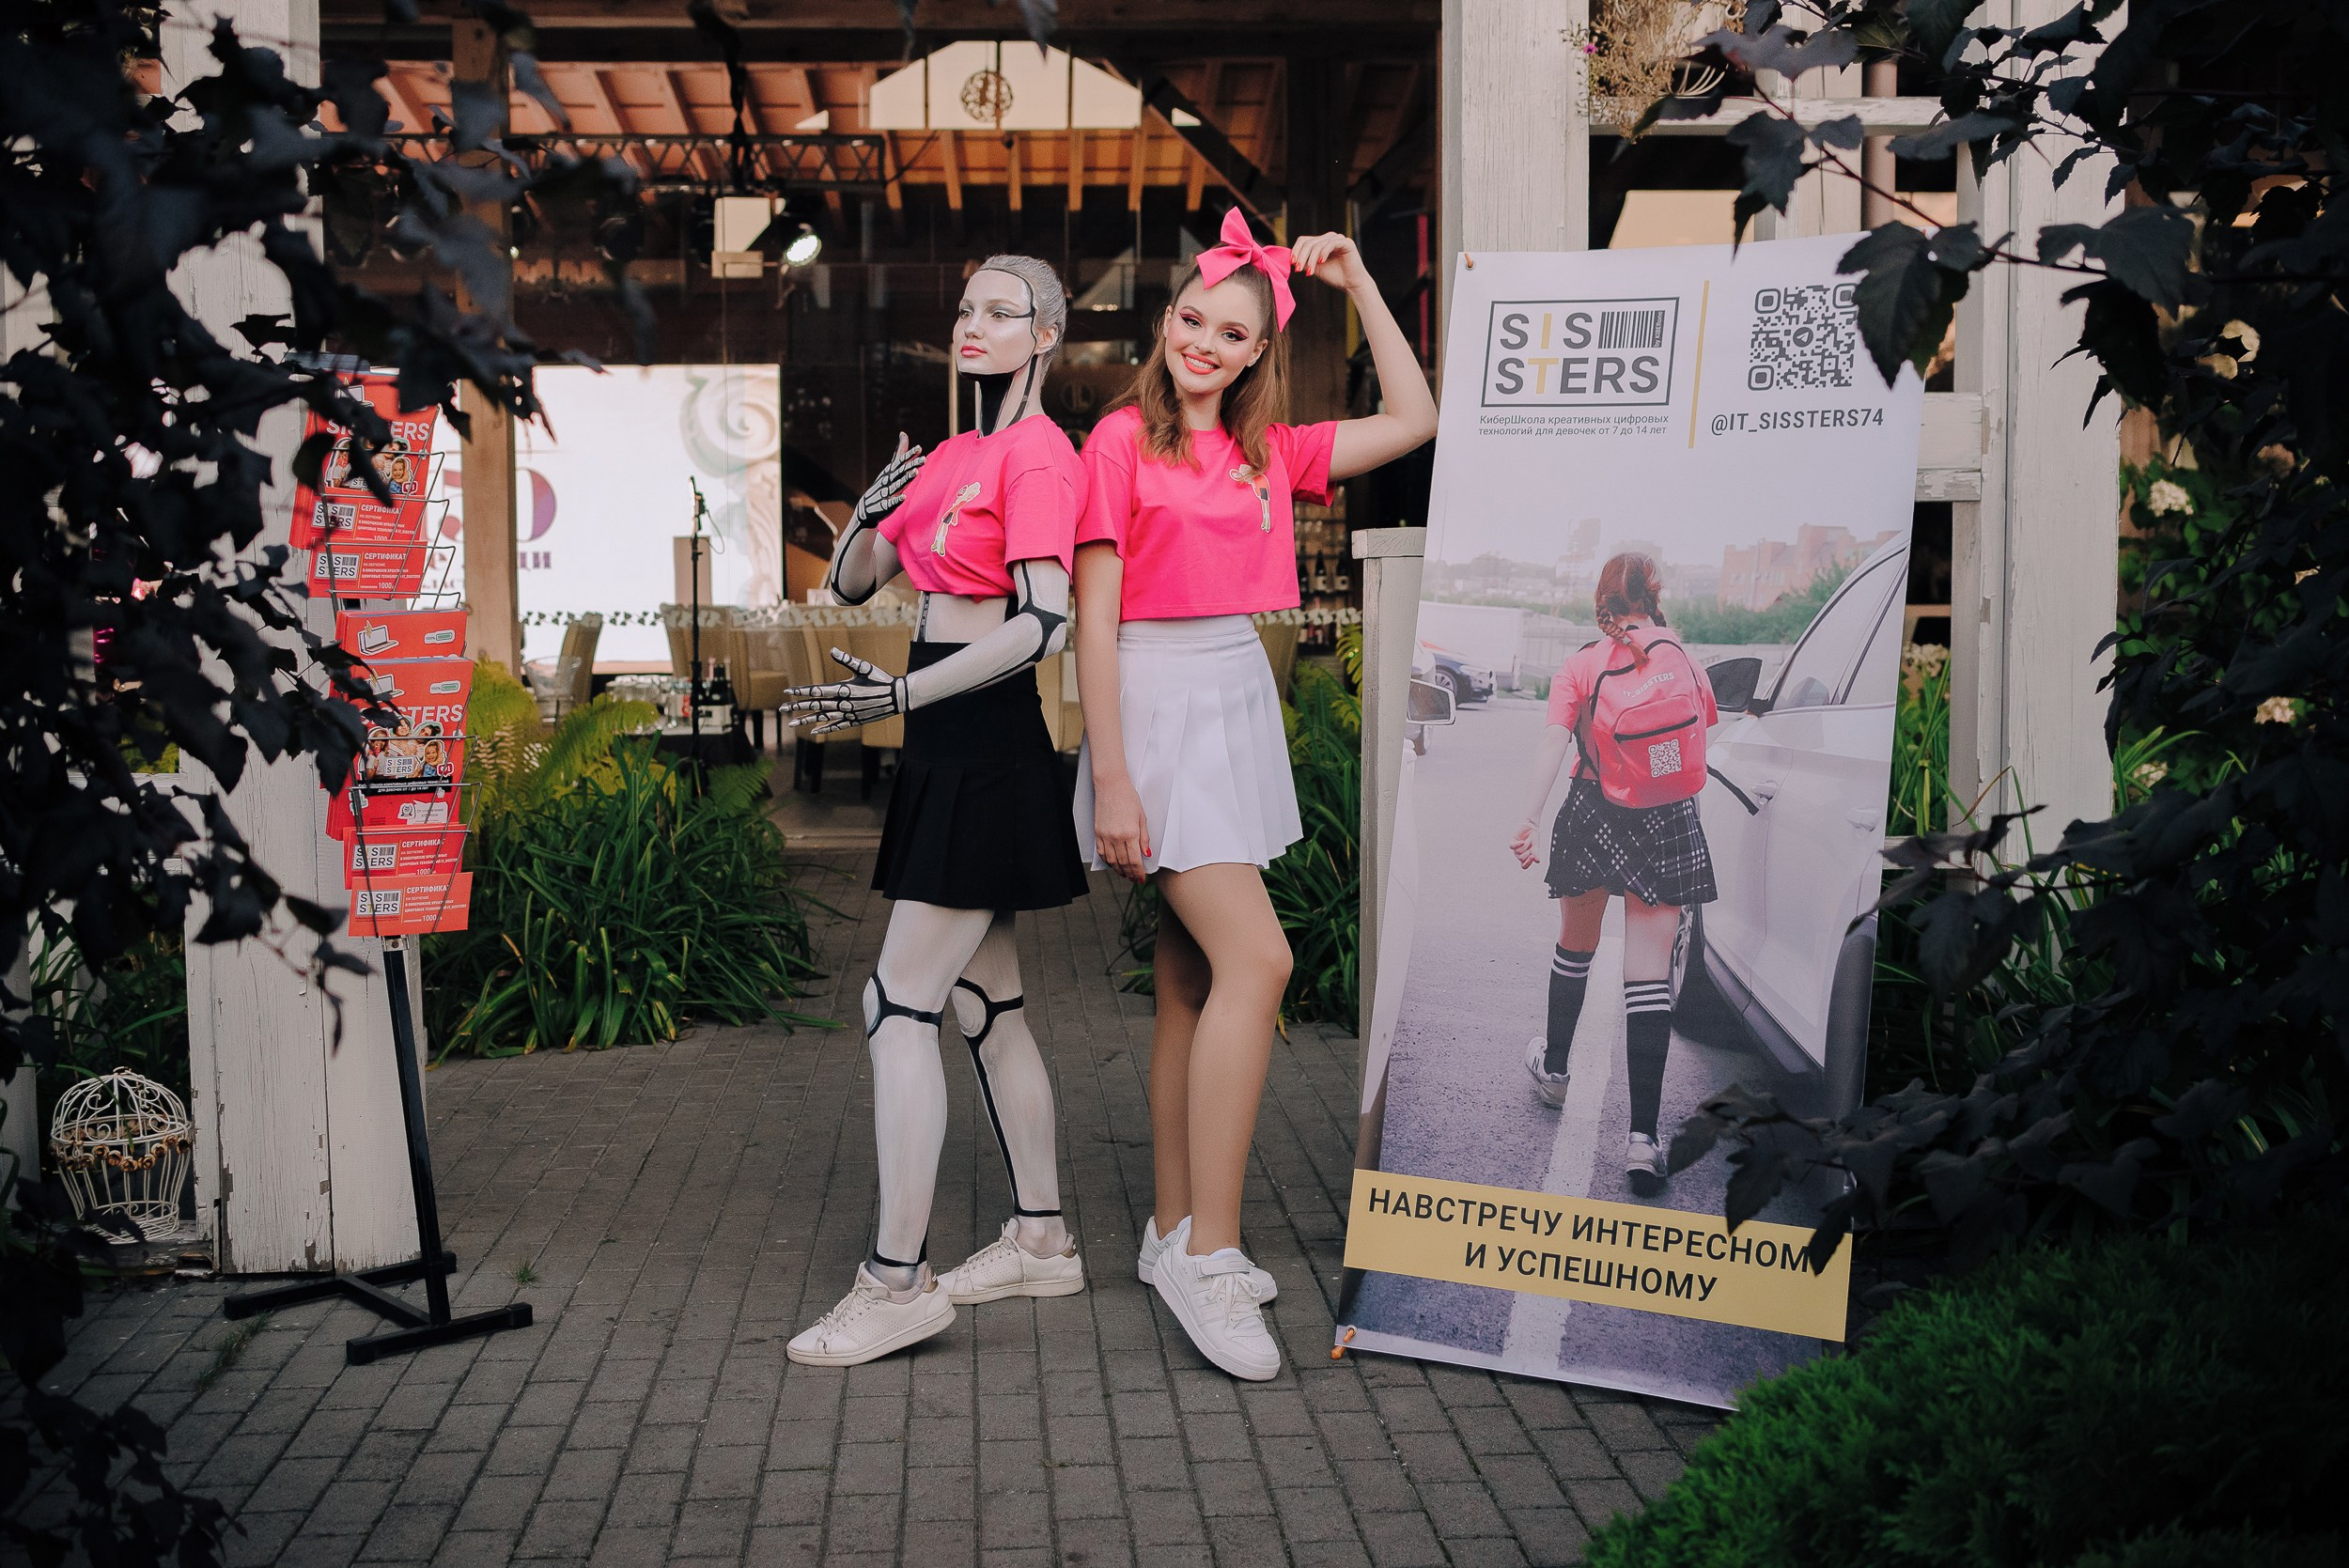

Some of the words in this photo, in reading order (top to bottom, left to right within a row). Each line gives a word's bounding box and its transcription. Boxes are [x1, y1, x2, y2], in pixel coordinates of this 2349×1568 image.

[1500, 311, 1594, 350] SIS
[1495, 354, 1660, 396] STERS
[1480, 414, 1546, 426] КиберШкола
[1548, 414, 1611, 426] креативных
[1613, 413, 1669, 426] цифровых
[1711, 407, 1884, 436] @IT_SISSTERS74
[1479, 426, 1532, 436] технологий
[1534, 427, 1554, 436] для
[1555, 427, 1596, 436] девочек
[1598, 427, 1610, 435] от
[1611, 426, 1618, 435] 7
[1620, 427, 1633, 436] до
[1636, 426, 1647, 434] 14
[319, 555, 342, 566] SS
[355, 857, 394, 867] SERS
[406, 885, 450, 893] СЕРТИФИКА
[360, 893, 382, 903] SS
[1368, 1187, 1562, 1236] НАВСТРЕЧУ
[1571, 1214, 1813, 1273] ИНТЕРЕСНОМ
[1465, 1242, 1486, 1268] И
[1497, 1245, 1719, 1302] УСПЕШНОМУ
